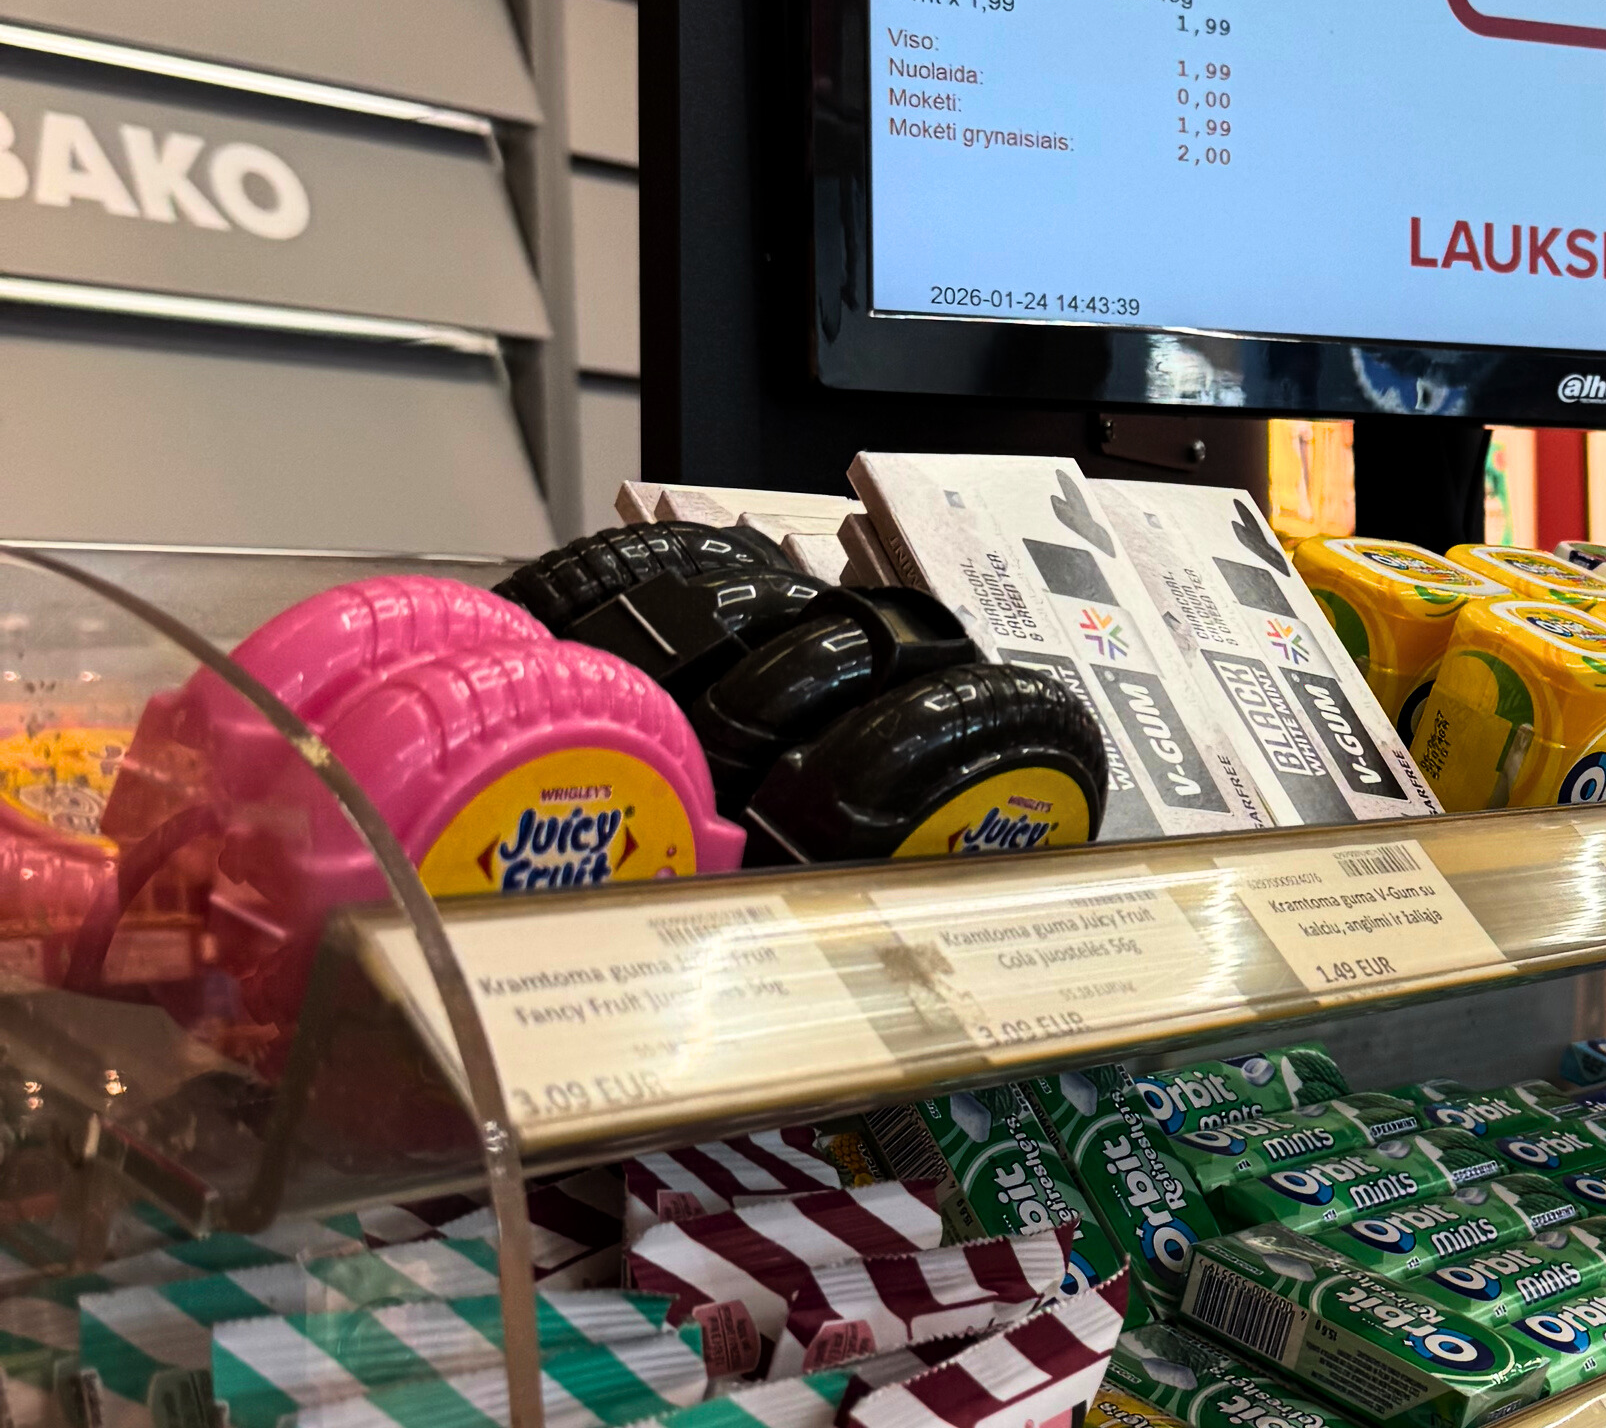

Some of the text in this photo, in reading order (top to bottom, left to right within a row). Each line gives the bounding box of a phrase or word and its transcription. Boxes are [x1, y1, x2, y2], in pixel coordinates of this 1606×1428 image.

[1177, 15, 1231, 37] 1,99
[888, 28, 1231, 81] Viso: 1,99
[889, 58, 1231, 110] Nuolaida: 0,00
[889, 87, 1231, 138] Mokėti: 1,99
[889, 117, 1231, 166] Mokėti grynaisiais: 2,00
[931, 286, 1140, 317] 2026-01-24 14:43:39
[1136, 682, 1203, 798] V-GUM
[1308, 684, 1383, 787] V-GUM
[500, 806, 624, 860] Juicy
[1269, 882, 1437, 915] Kramtoma guma V-Gum su
[939, 905, 1155, 953] Kramtoma guma Juicy Fruit
[478, 960, 674, 998] Kramtoma guma
[1316, 955, 1397, 985] 1.49 EUR
[515, 992, 648, 1029] Fancy Fruit
[1281, 1146, 1381, 1199] Orbit
[1348, 1169, 1419, 1215] mints
[1431, 1204, 1576, 1258] mints SPEARMINT
